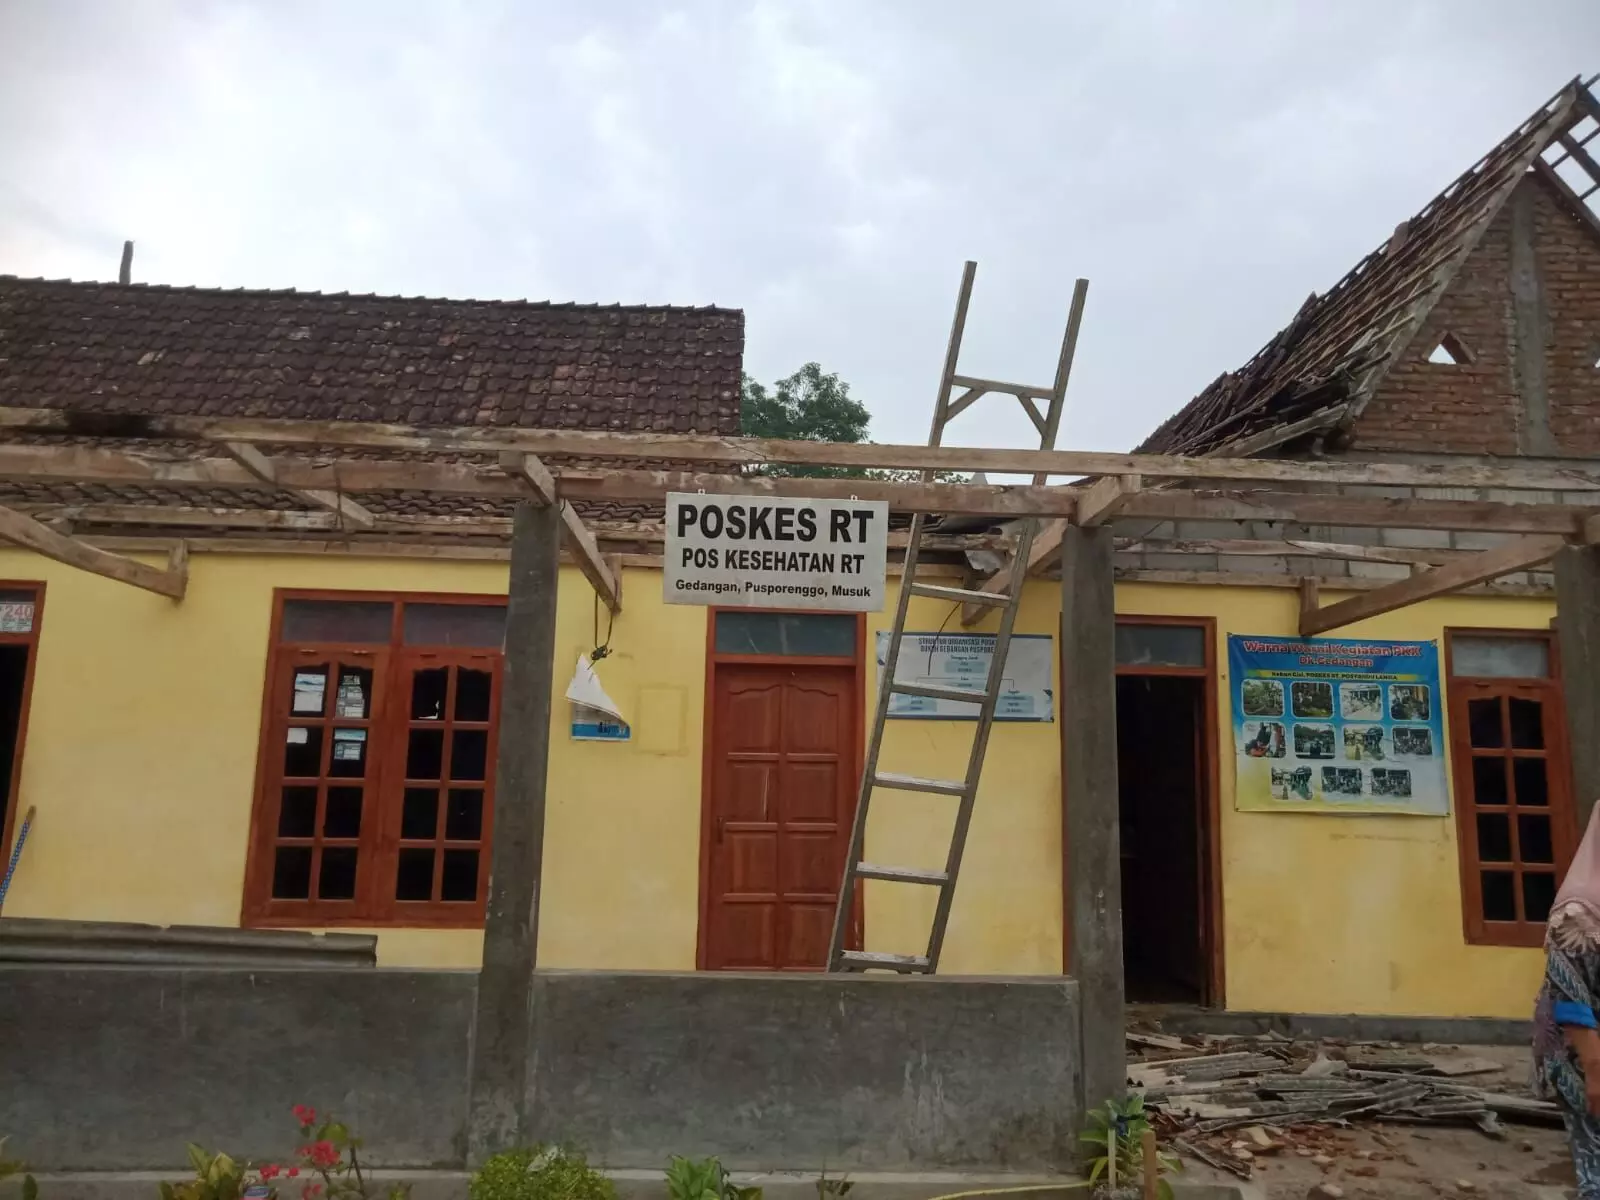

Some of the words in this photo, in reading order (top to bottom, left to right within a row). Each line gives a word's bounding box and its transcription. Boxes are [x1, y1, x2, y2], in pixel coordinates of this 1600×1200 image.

[677, 504, 817, 542] POSKES
[830, 509, 874, 543] RT
[682, 547, 719, 569] POS
[725, 549, 835, 573] KESEHATAN
[841, 554, 865, 574] RT
[675, 579, 741, 595] Gedangan,
[745, 581, 828, 598] Pusporenggo,
[831, 585, 871, 597] Musuk
[1243, 641, 1289, 653] Warna
[1329, 644, 1391, 657] Kegiatan
